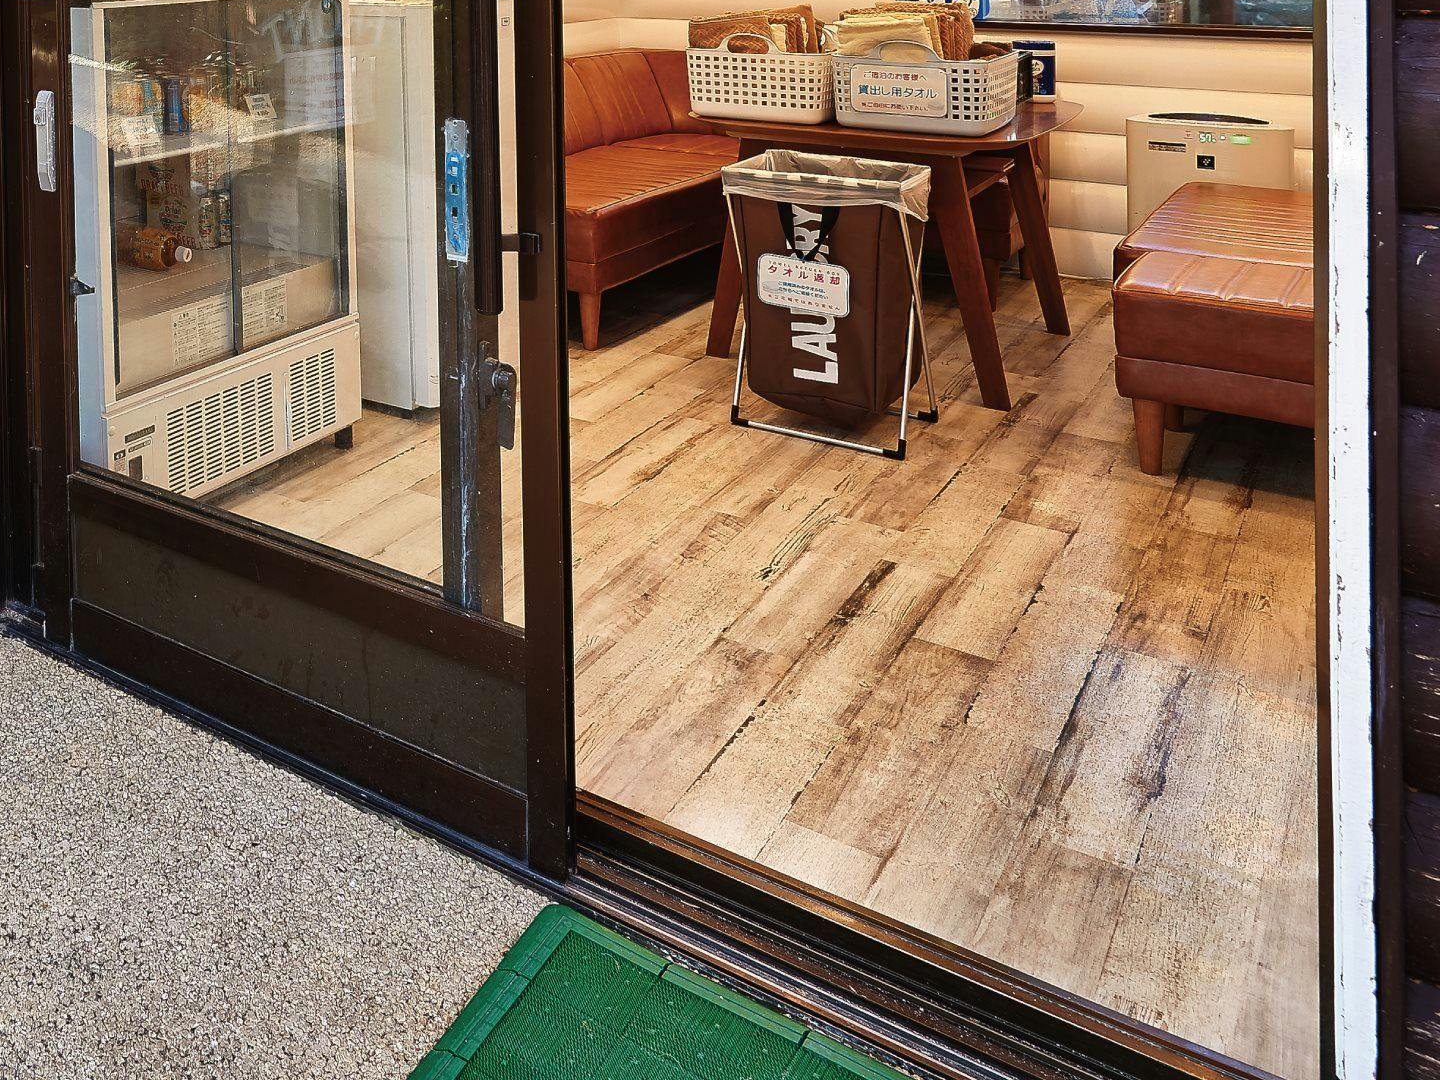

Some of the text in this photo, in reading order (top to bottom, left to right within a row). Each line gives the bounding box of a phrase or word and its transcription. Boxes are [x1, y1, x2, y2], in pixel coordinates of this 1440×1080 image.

[863, 70, 927, 81] ご宿泊のお客様へ
[858, 84, 938, 99] 貸出し用タオル
[768, 264, 841, 285] タオル返却
[786, 204, 839, 385] LAURY
